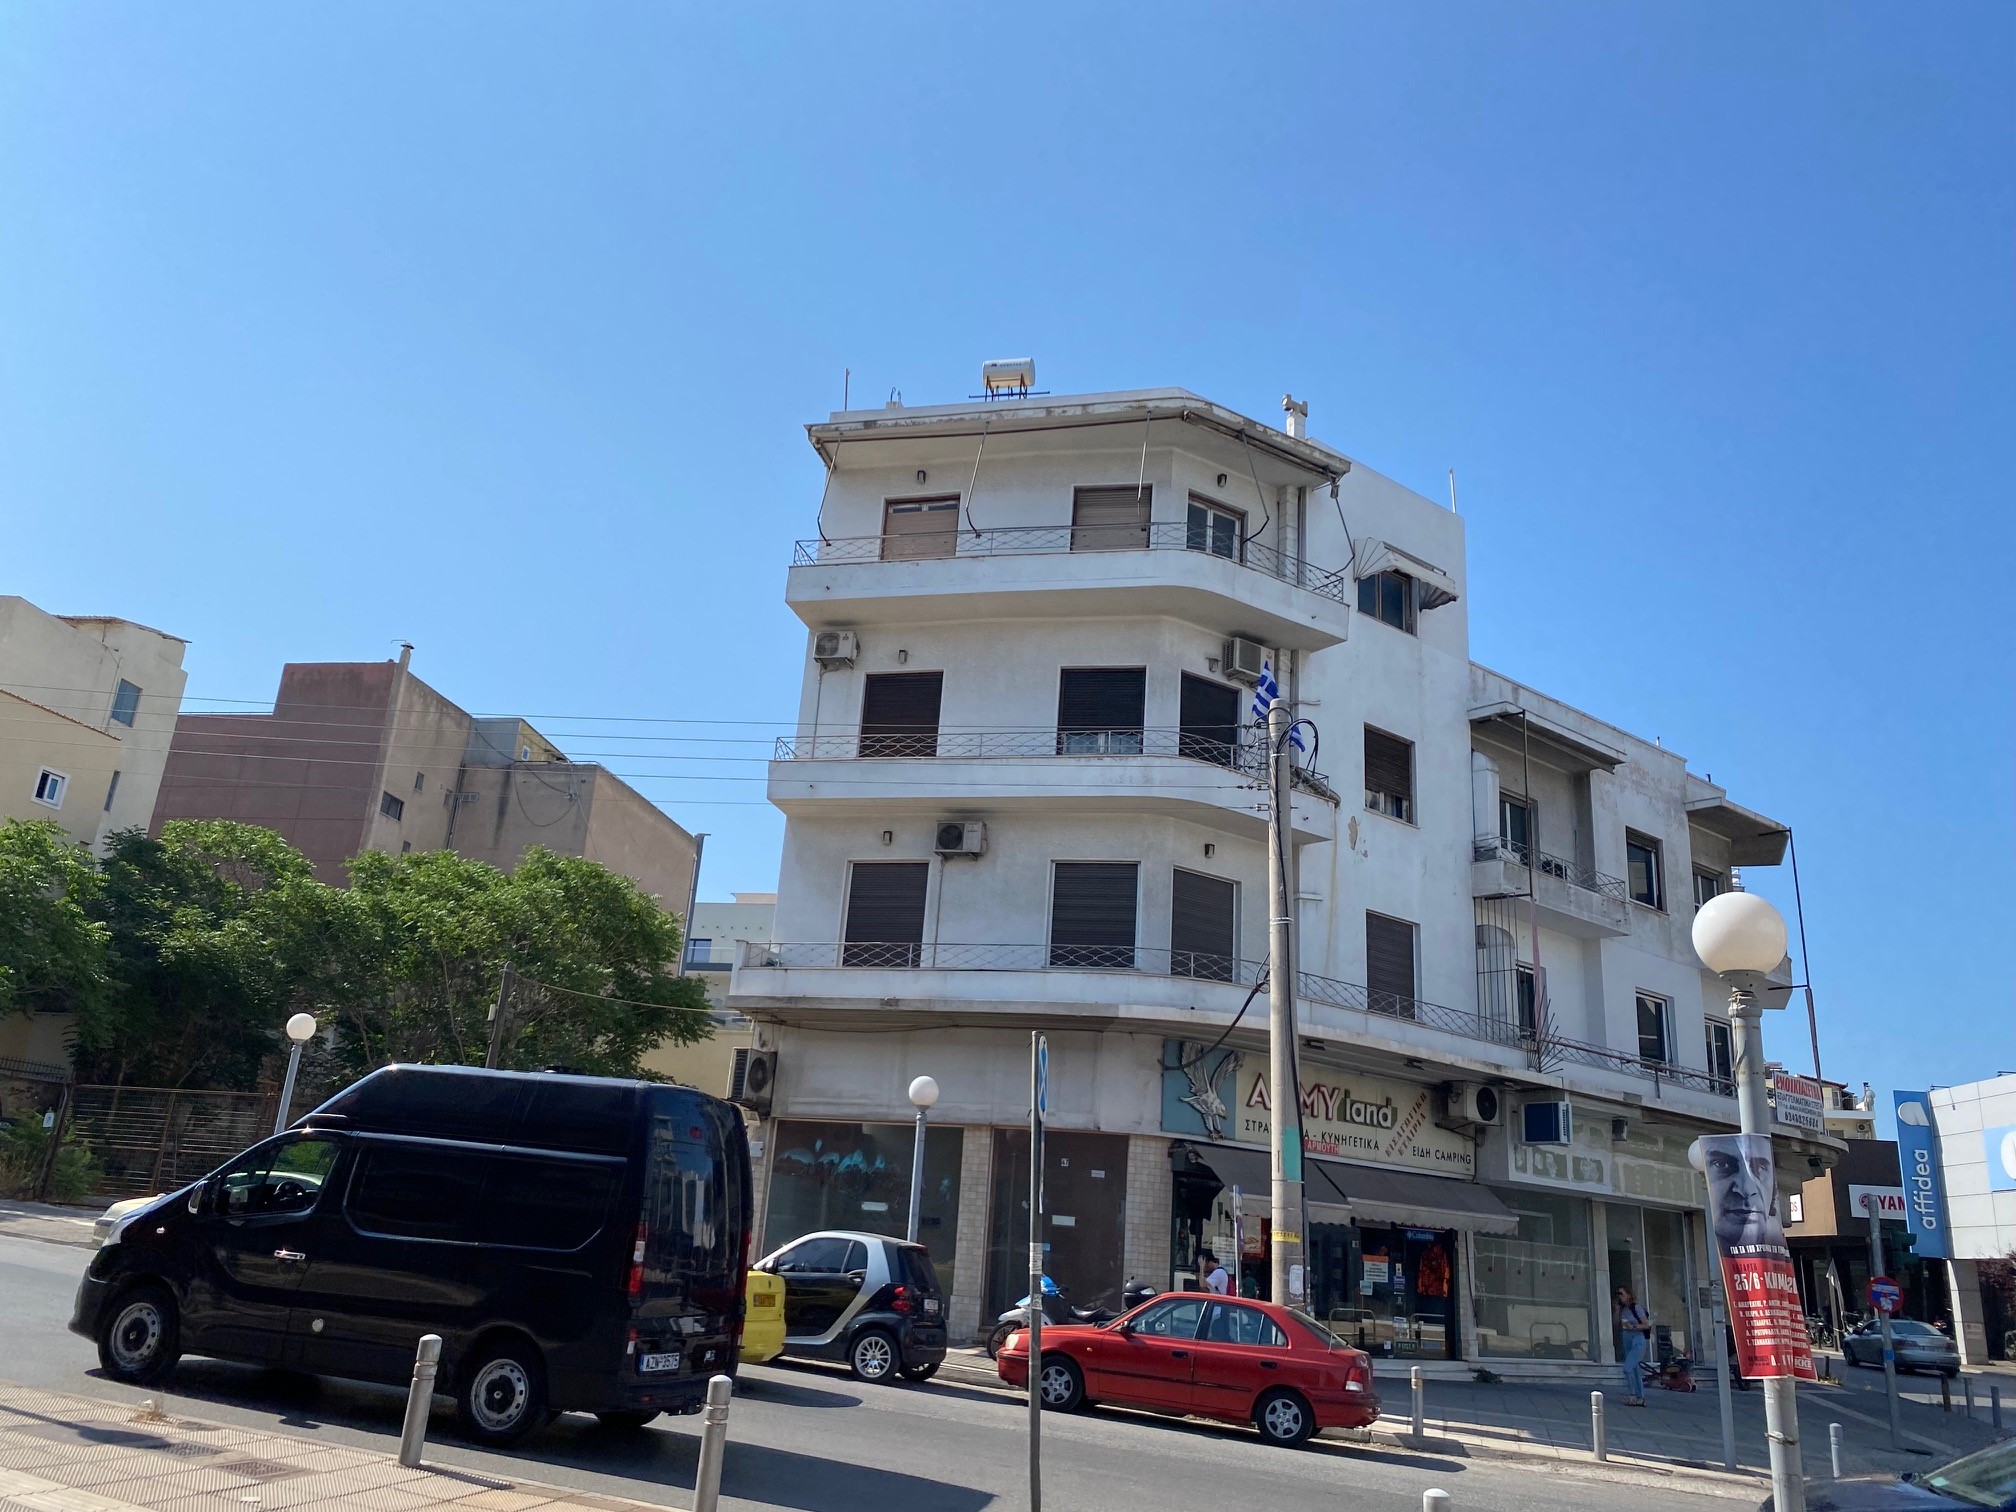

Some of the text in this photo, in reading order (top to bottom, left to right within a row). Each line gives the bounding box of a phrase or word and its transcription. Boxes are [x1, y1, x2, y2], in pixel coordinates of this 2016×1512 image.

[1246, 1072, 1393, 1129] AMY land
[1321, 1131, 1380, 1151] ΚΥΝΗΓΕΤΙΚΑ
[1412, 1146, 1472, 1165] ΕΙΔΗ CAMPING
[1911, 1149, 1937, 1230] affidea
